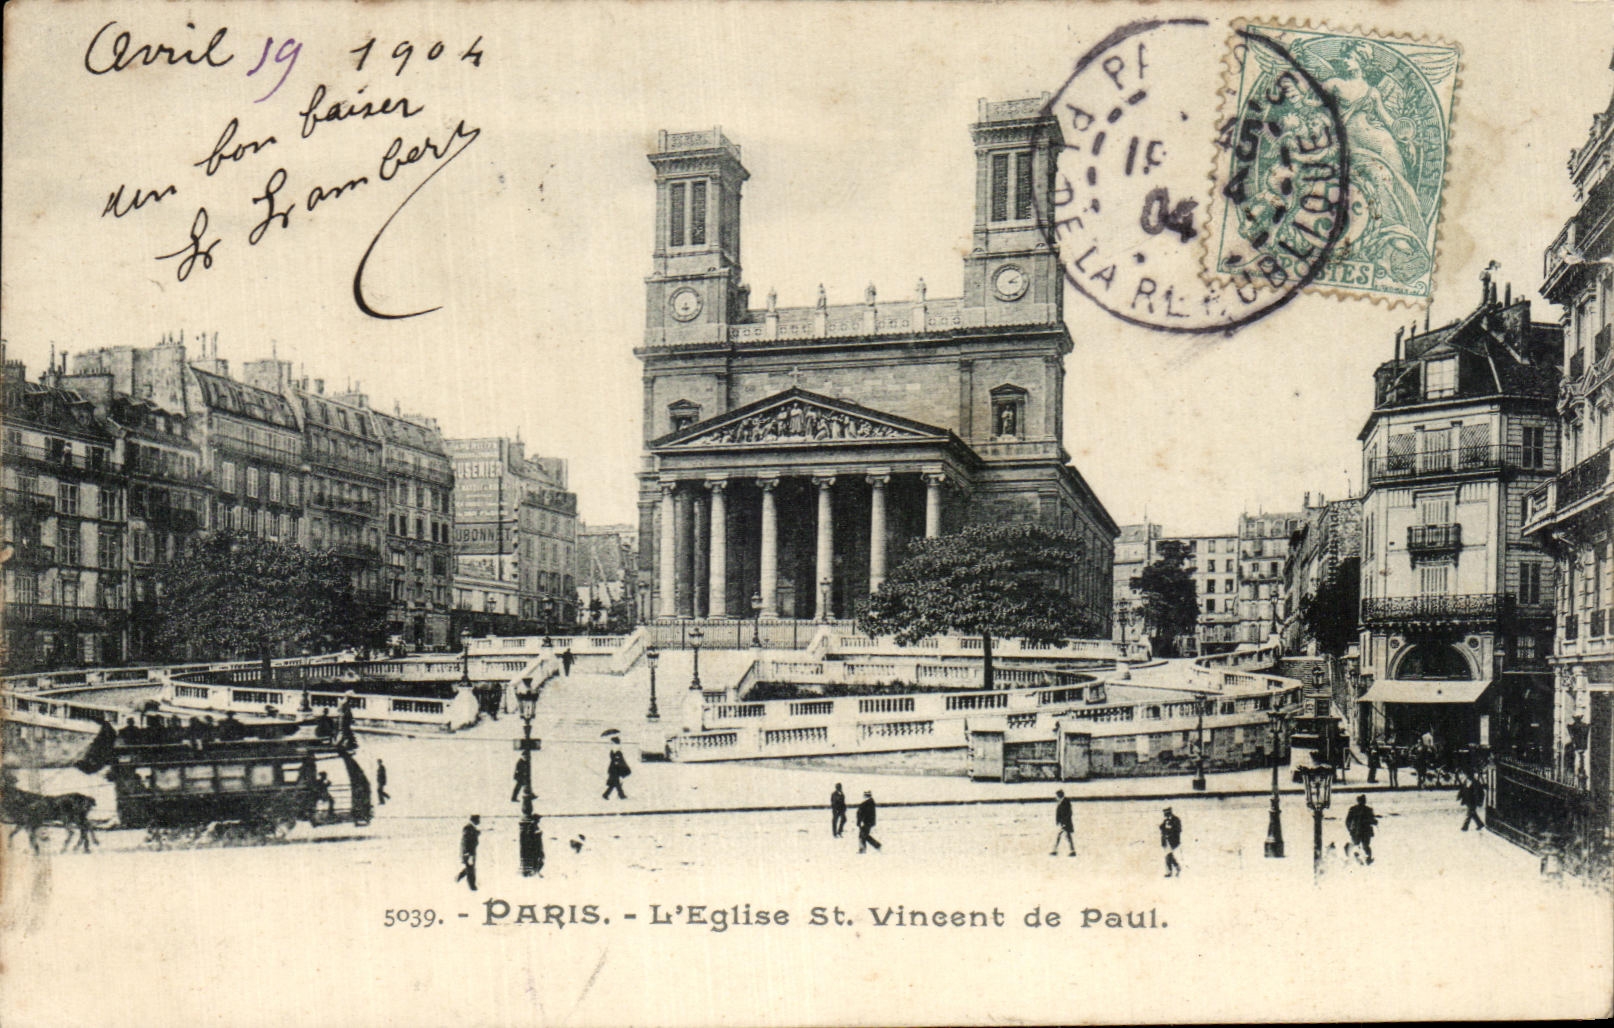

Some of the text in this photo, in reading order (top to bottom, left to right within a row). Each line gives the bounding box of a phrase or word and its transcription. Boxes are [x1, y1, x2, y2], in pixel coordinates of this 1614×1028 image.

[246, 37, 304, 104] 19
[351, 35, 486, 77] 1904
[194, 117, 277, 176] bon
